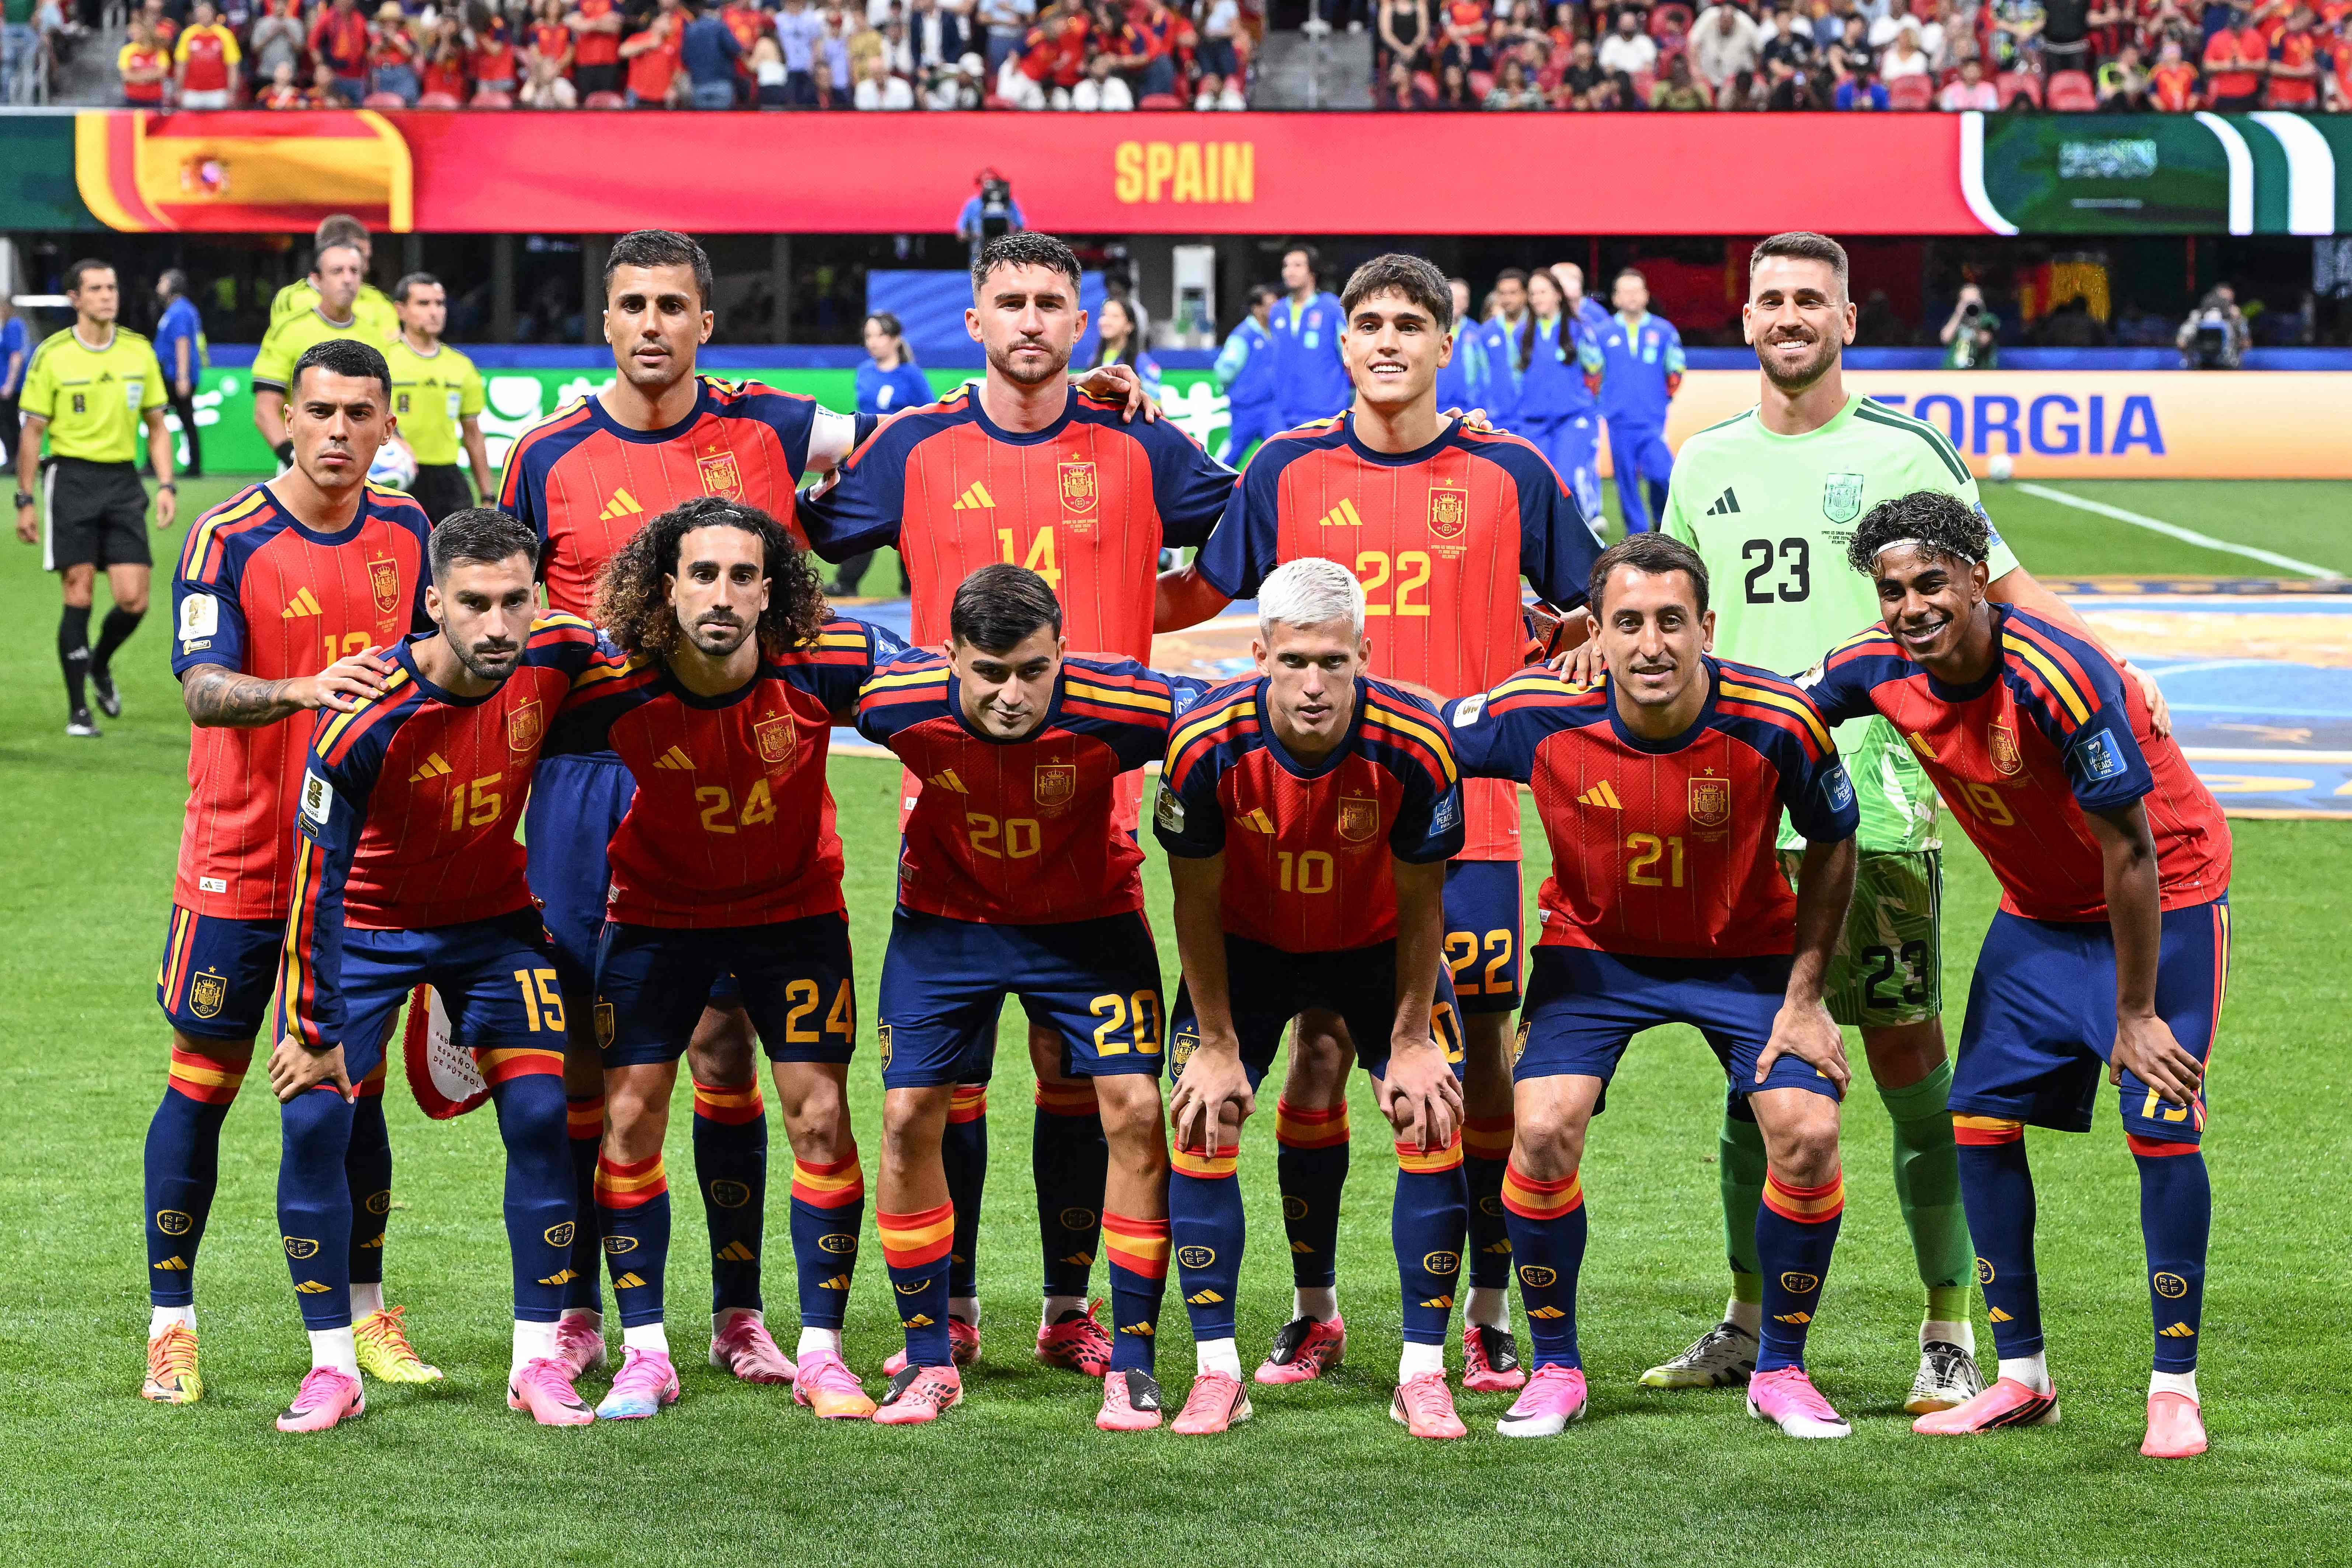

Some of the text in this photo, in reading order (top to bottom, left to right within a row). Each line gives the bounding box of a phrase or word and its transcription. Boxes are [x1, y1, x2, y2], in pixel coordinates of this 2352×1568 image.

[1115, 142, 1254, 203] SPAIN
[1871, 394, 2165, 456] ORGIA
[998, 526, 1061, 590] 14
[1356, 551, 1431, 616] 22
[1742, 538, 1810, 604] 23
[2093, 758, 2114, 772] PEACE
[452, 772, 502, 831] 15
[695, 778, 777, 834] 24
[1436, 812, 1453, 826] PEACE
[1951, 776, 2015, 826] 19
[966, 812, 1041, 859] 20
[1626, 832, 1684, 887] 21
[1278, 850, 1333, 894] 10
[1444, 928, 1513, 996] 22
[1861, 939, 1930, 1009] 23
[514, 968, 566, 1033] 15
[785, 978, 854, 1044] 24
[1089, 989, 1161, 1057] 20
[1431, 1001, 1465, 1064] 0
[434, 1056, 480, 1088] DE FÚTBOL
[164, 1214, 185, 1223] RF
[164, 1221, 182, 1230] EF
[289, 1240, 307, 1248] RF
[555, 1226, 571, 1235] RF
[2160, 1277, 2178, 1286] RF
